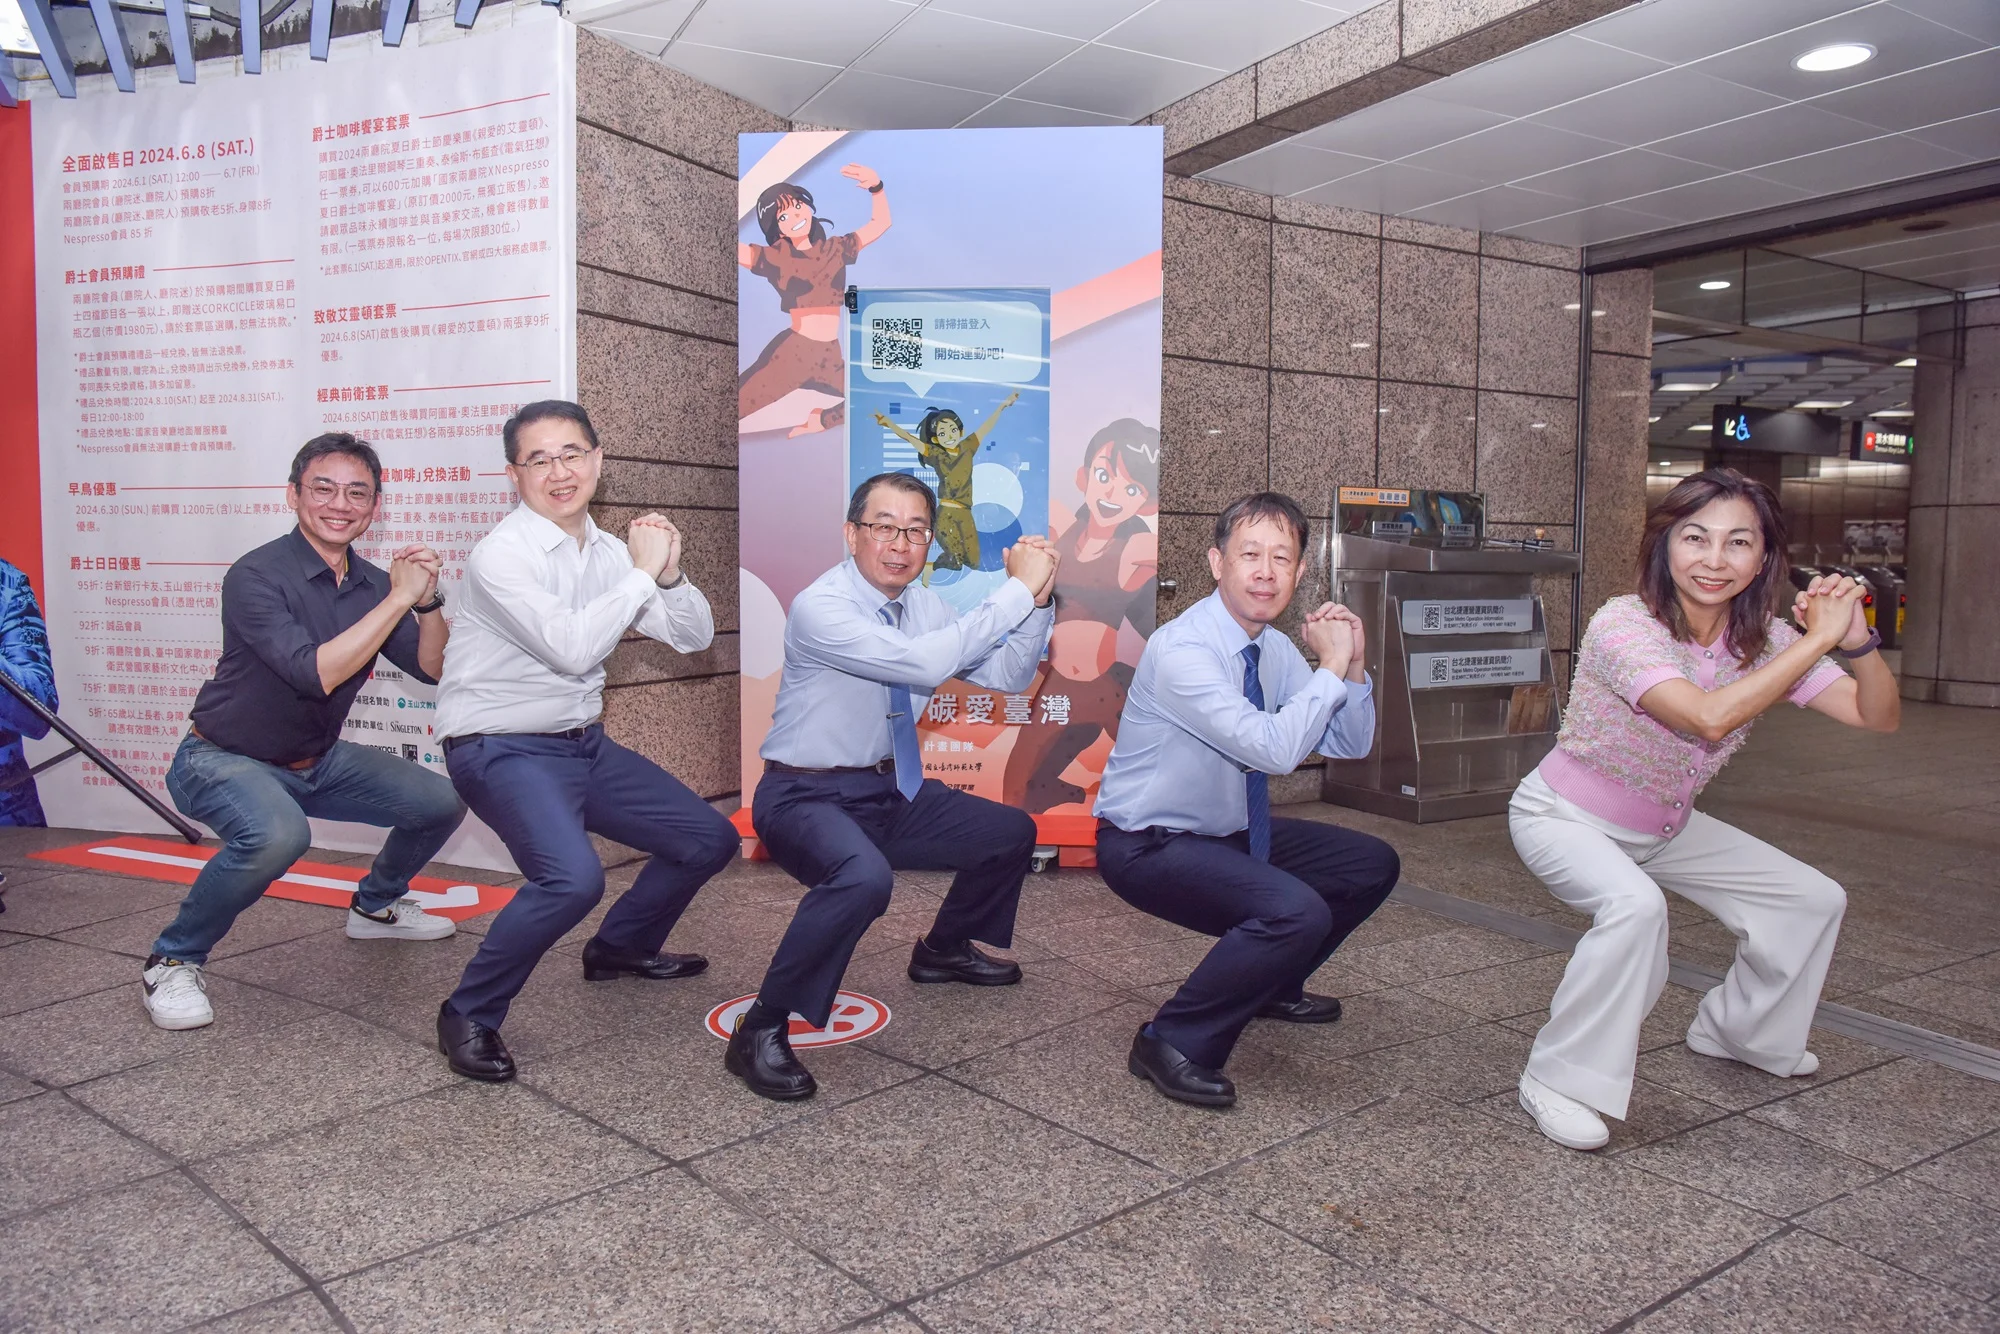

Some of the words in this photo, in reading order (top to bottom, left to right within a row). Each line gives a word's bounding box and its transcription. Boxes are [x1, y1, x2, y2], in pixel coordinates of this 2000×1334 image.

[312, 113, 410, 142] 爵士咖啡饗宴套票
[62, 150, 135, 173] 全面啟售日
[140, 144, 206, 164] 2024.6.8
[211, 137, 254, 160] (SAT.)
[62, 180, 110, 194] 會員預購期
[112, 176, 146, 189] 2024.6.1
[148, 173, 173, 187] (SAT.)
[176, 171, 200, 184] 12:00
[223, 168, 236, 178] 6.7
[130, 229, 141, 239] 85
[144, 227, 153, 237] 折
[65, 265, 145, 285] 爵士會員預購禮
[314, 303, 397, 325] 致敬艾靈頓套票
[934, 318, 991, 330] 請掃描登入
[321, 349, 344, 362] 優惠。
[934, 347, 1004, 361] 開始運動吧!
[316, 385, 389, 403] 經典前衛套票
[68, 482, 117, 497] 早鳥優惠
[381, 491, 519, 505] 日爵士節慶樂團《親愛的艾靈頓
[75, 504, 119, 515] 2024.6.30
[121, 504, 149, 516] (SUN.)
[151, 504, 180, 515] 前購買
[76, 521, 101, 532] 優惠。
[357, 530, 492, 542] 新銀行兩廳院夏日爵士戶外派
[70, 556, 141, 571] 爵士日日優惠
[82, 683, 202, 697] 75折：廳院青（適用於全面啟
[927, 693, 1071, 725] 碳愛臺灣
[924, 741, 974, 753] 計畫團隊
[924, 762, 983, 773] 國立臺灣師範大學
